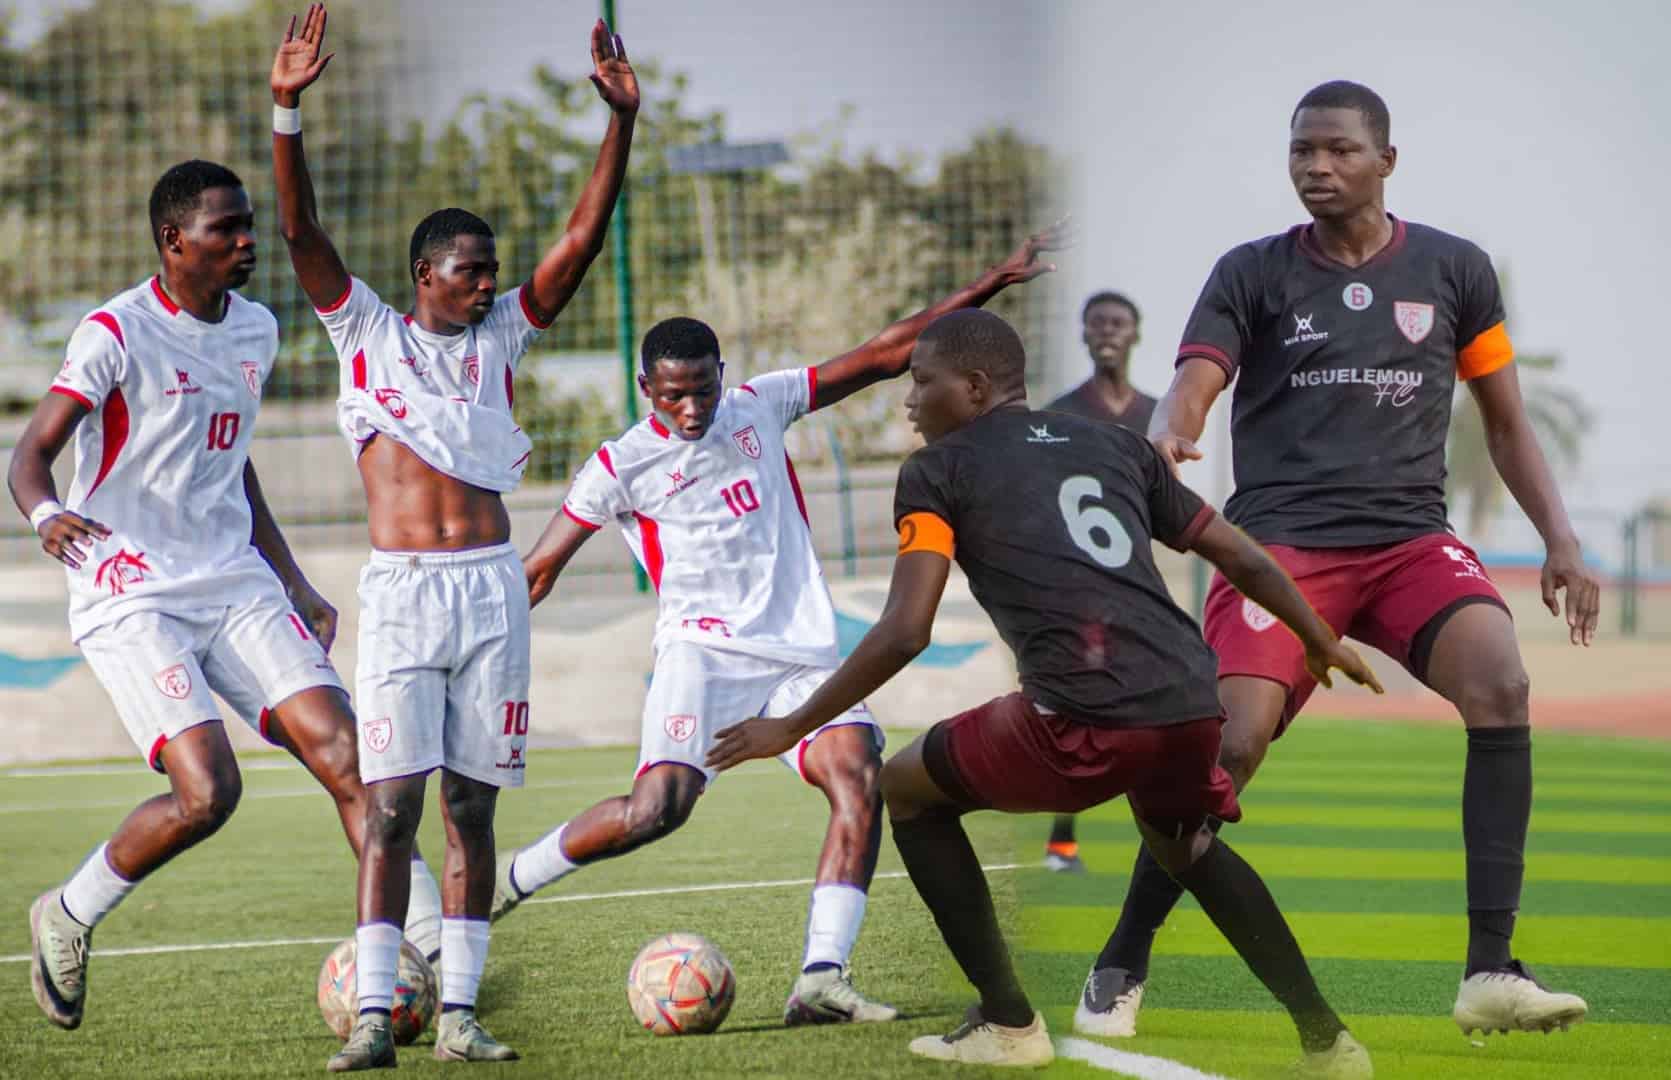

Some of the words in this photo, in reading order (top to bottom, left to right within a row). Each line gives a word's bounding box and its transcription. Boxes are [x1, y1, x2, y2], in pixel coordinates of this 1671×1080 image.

[1351, 287, 1365, 306] 6
[1301, 331, 1328, 342] SPORT
[1291, 368, 1423, 387] NGUELEMOU
[207, 412, 240, 450] 10
[721, 480, 760, 517] 10
[1058, 475, 1132, 568] 6
[288, 613, 310, 641] 1
[504, 701, 529, 736] 10
